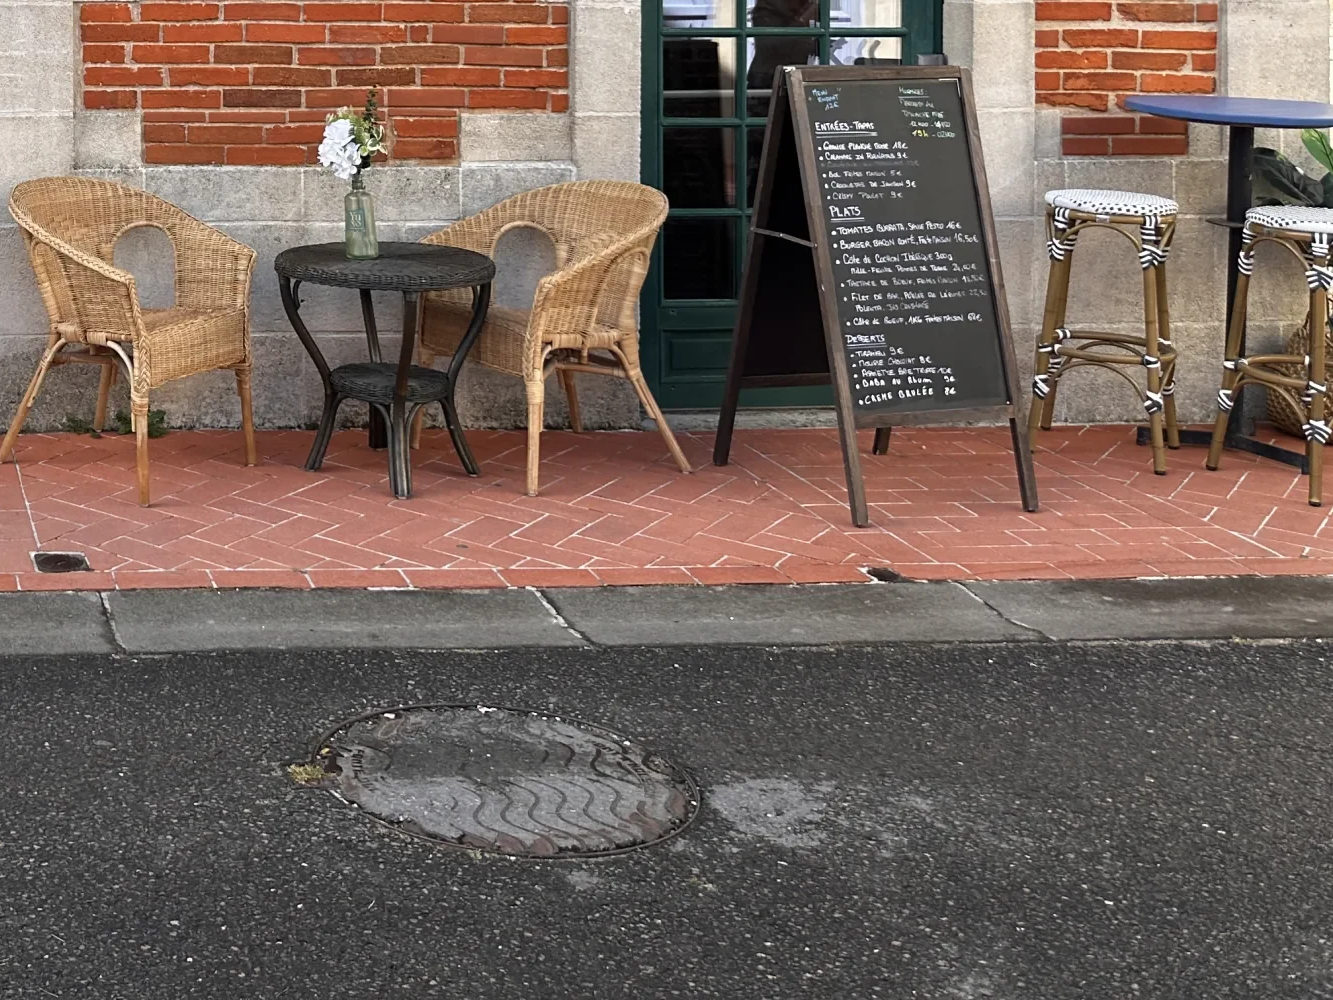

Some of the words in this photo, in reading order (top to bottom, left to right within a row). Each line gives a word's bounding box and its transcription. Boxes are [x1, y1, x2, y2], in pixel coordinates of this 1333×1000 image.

[906, 179, 917, 187] 9€
[829, 205, 861, 217] PLATS
[862, 378, 885, 388] BABA
